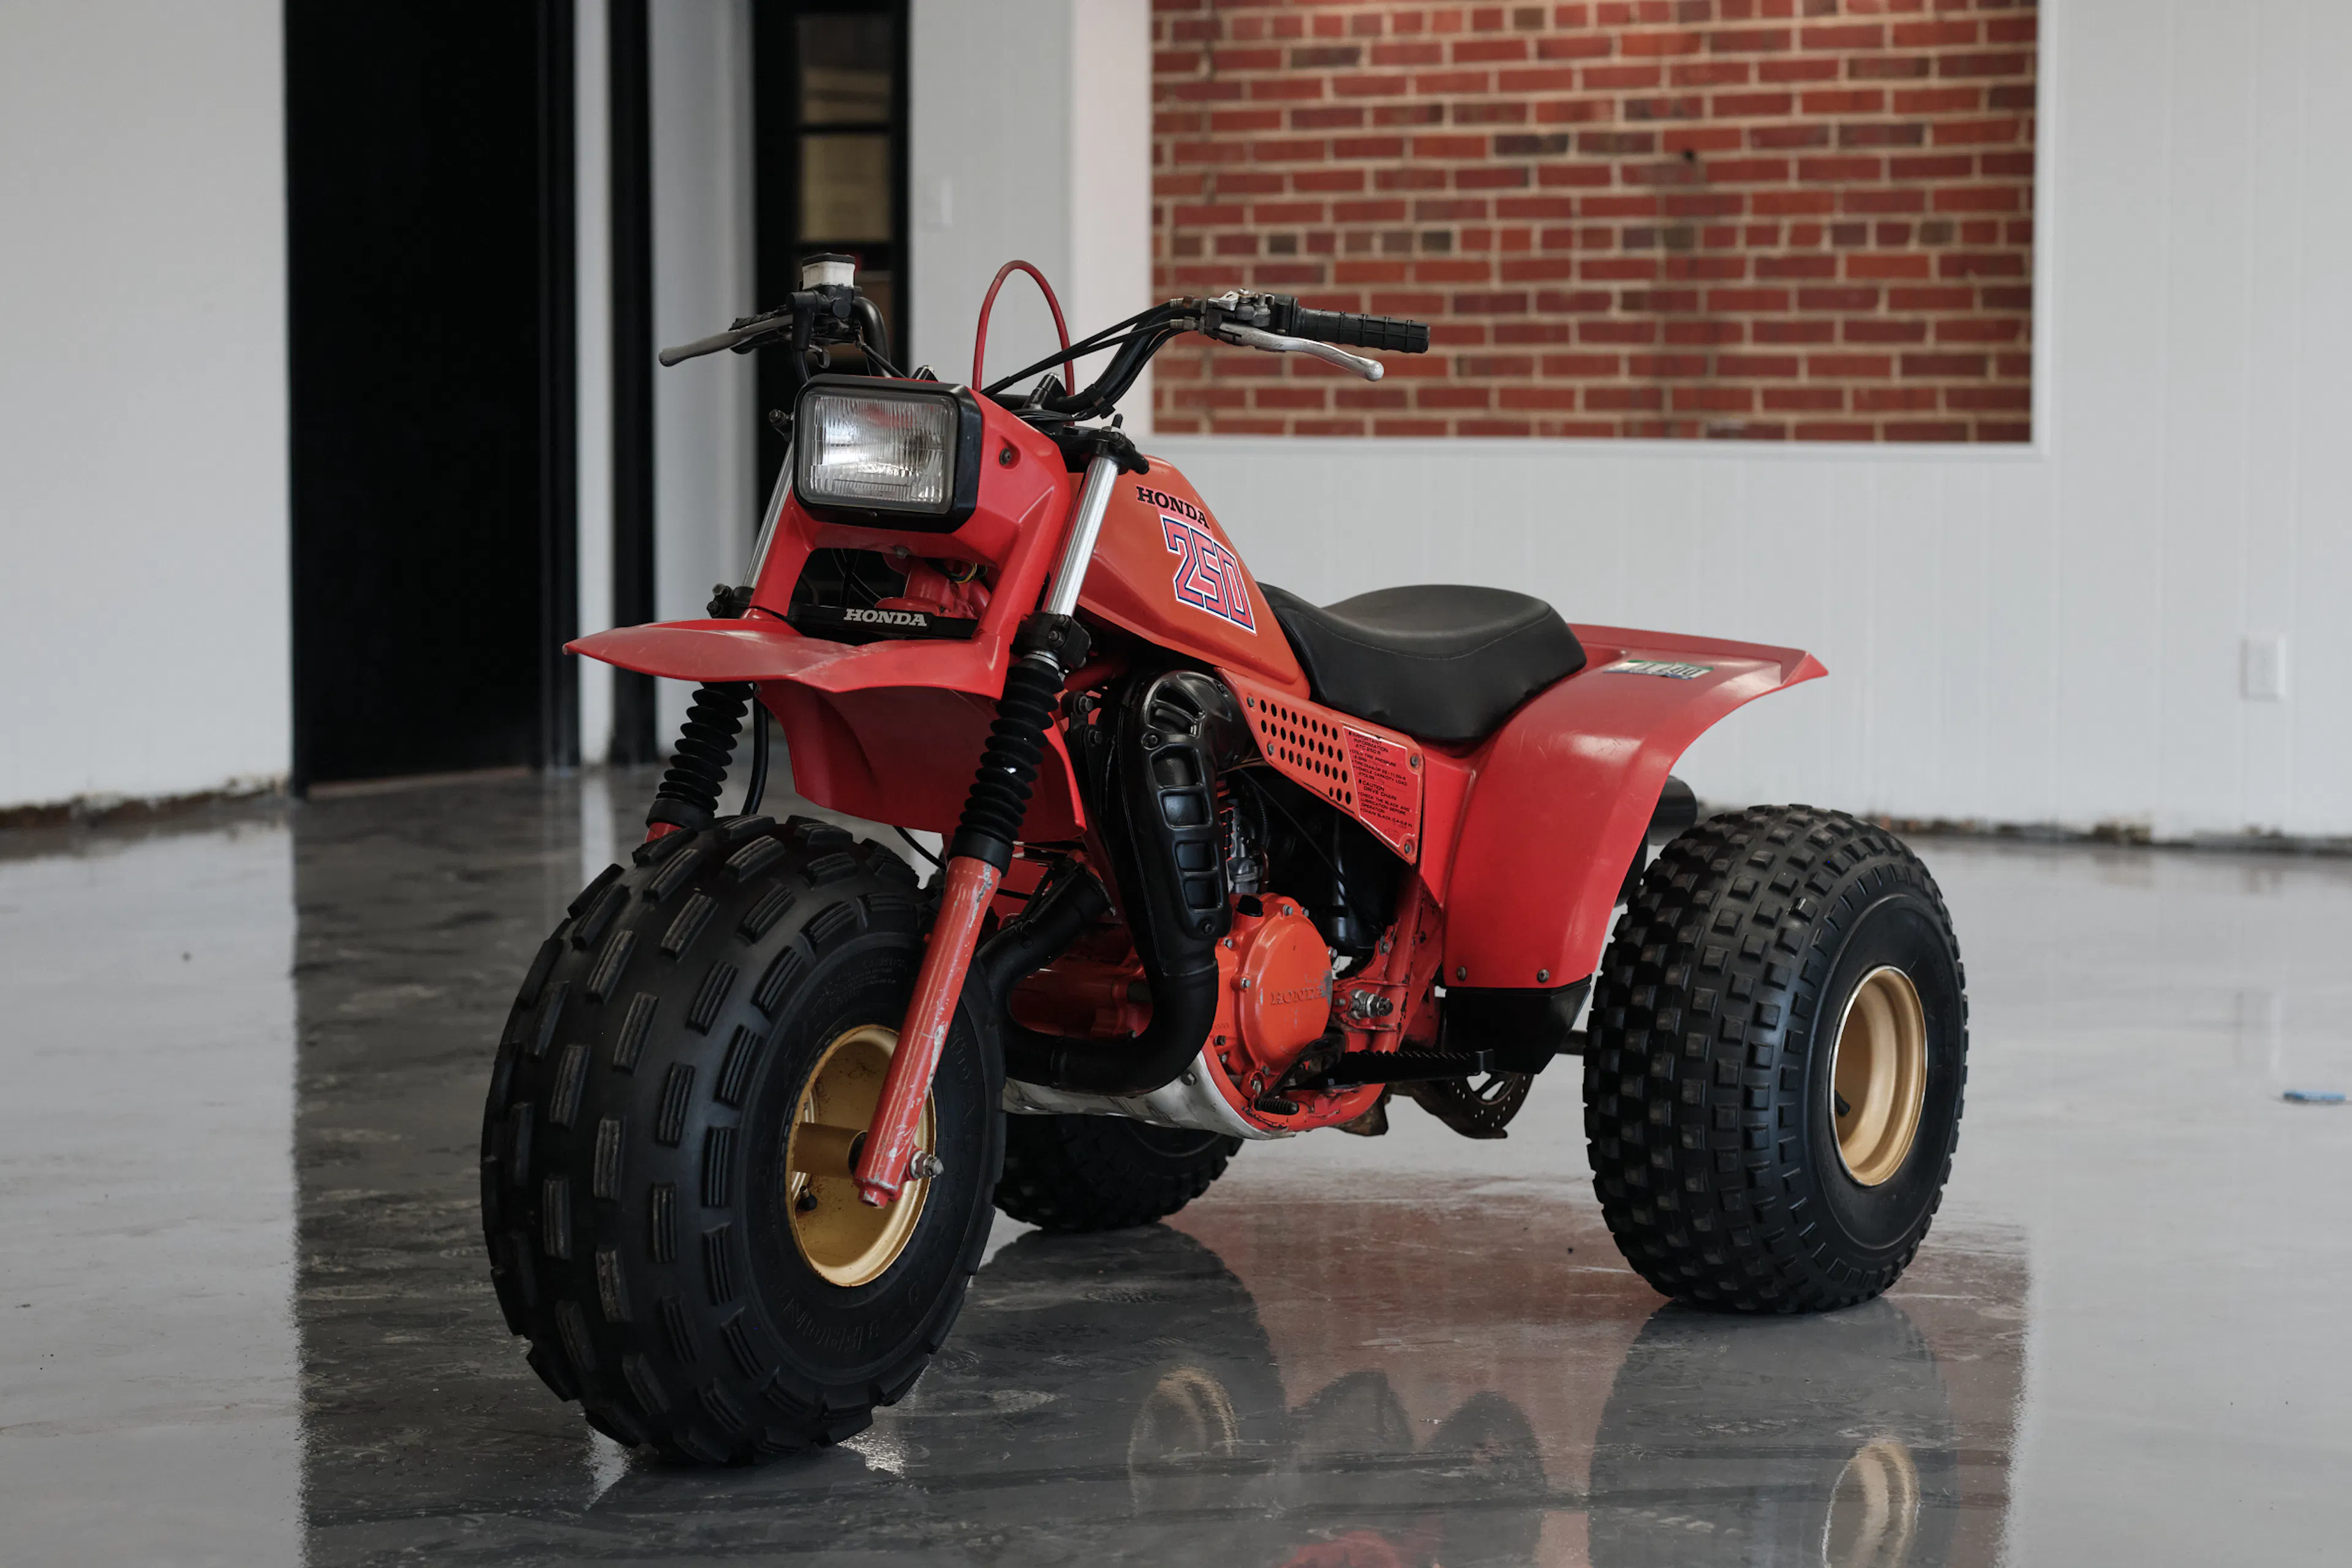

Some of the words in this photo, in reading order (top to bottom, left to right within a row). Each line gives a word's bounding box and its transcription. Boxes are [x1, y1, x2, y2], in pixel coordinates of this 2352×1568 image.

[1136, 486, 1210, 529] HONDA
[1160, 514, 1256, 634] 250
[843, 608, 927, 627] HONDA
[1354, 738, 1389, 753] INFORMATION
[1374, 772, 1394, 781] CAPACITY
[1362, 780, 1384, 791] CAUTION
[1363, 786, 1379, 794] DRIVE
[1381, 791, 1396, 801] CHAIN
[1361, 802, 1385, 813] OPERATION
[1270, 984, 1325, 1005] HONDA
